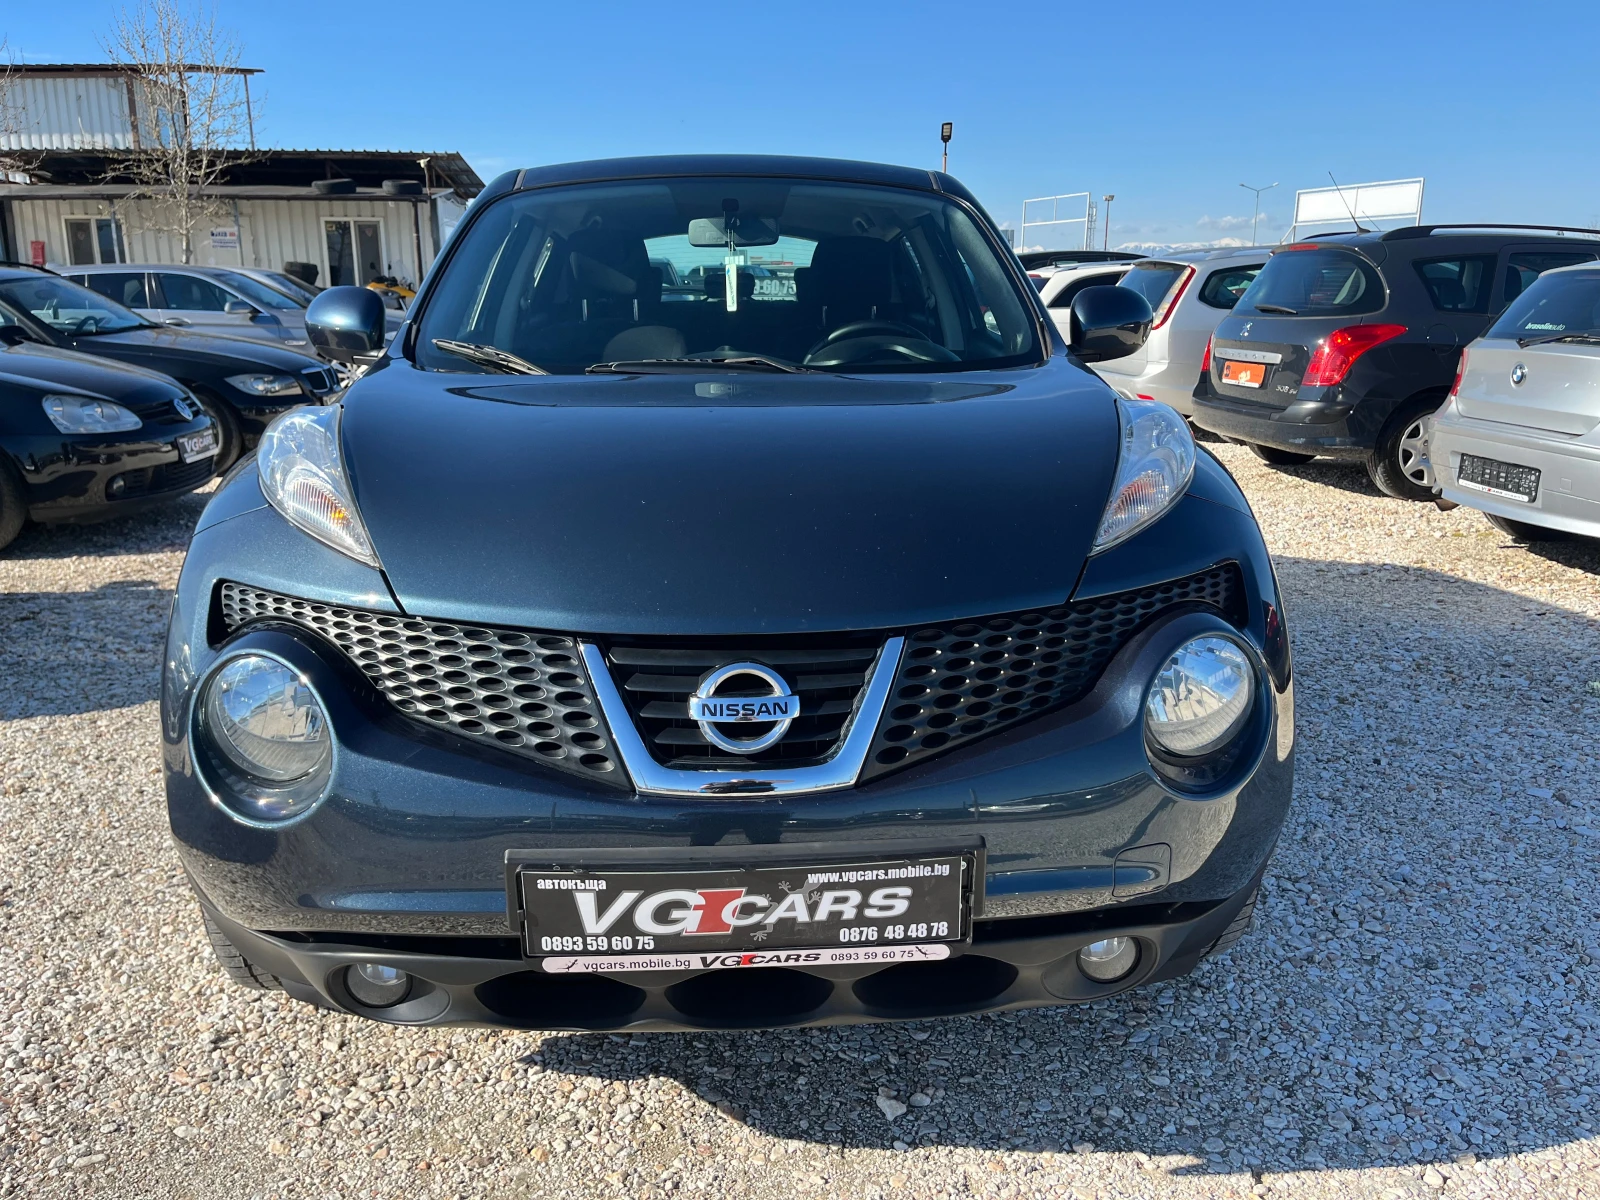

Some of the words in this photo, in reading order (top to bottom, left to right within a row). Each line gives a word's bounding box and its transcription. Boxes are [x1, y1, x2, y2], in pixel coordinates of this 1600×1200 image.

[702, 701, 788, 716] NISSAN
[808, 864, 950, 883] www.vgcars.mobile.bg
[537, 878, 607, 891] автокъща
[840, 926, 878, 942] 0876
[884, 924, 905, 939] 48
[908, 922, 928, 938] 48
[931, 921, 948, 937] 78
[541, 936, 584, 952] 0893
[586, 936, 608, 951] 59
[611, 935, 633, 950] 60
[635, 935, 655, 950] 75
[583, 958, 691, 973] vgcars.mobile.bg
[830, 952, 860, 962] 0893
[863, 951, 878, 961] 59
[881, 950, 896, 960] 60
[899, 949, 914, 959] 75
